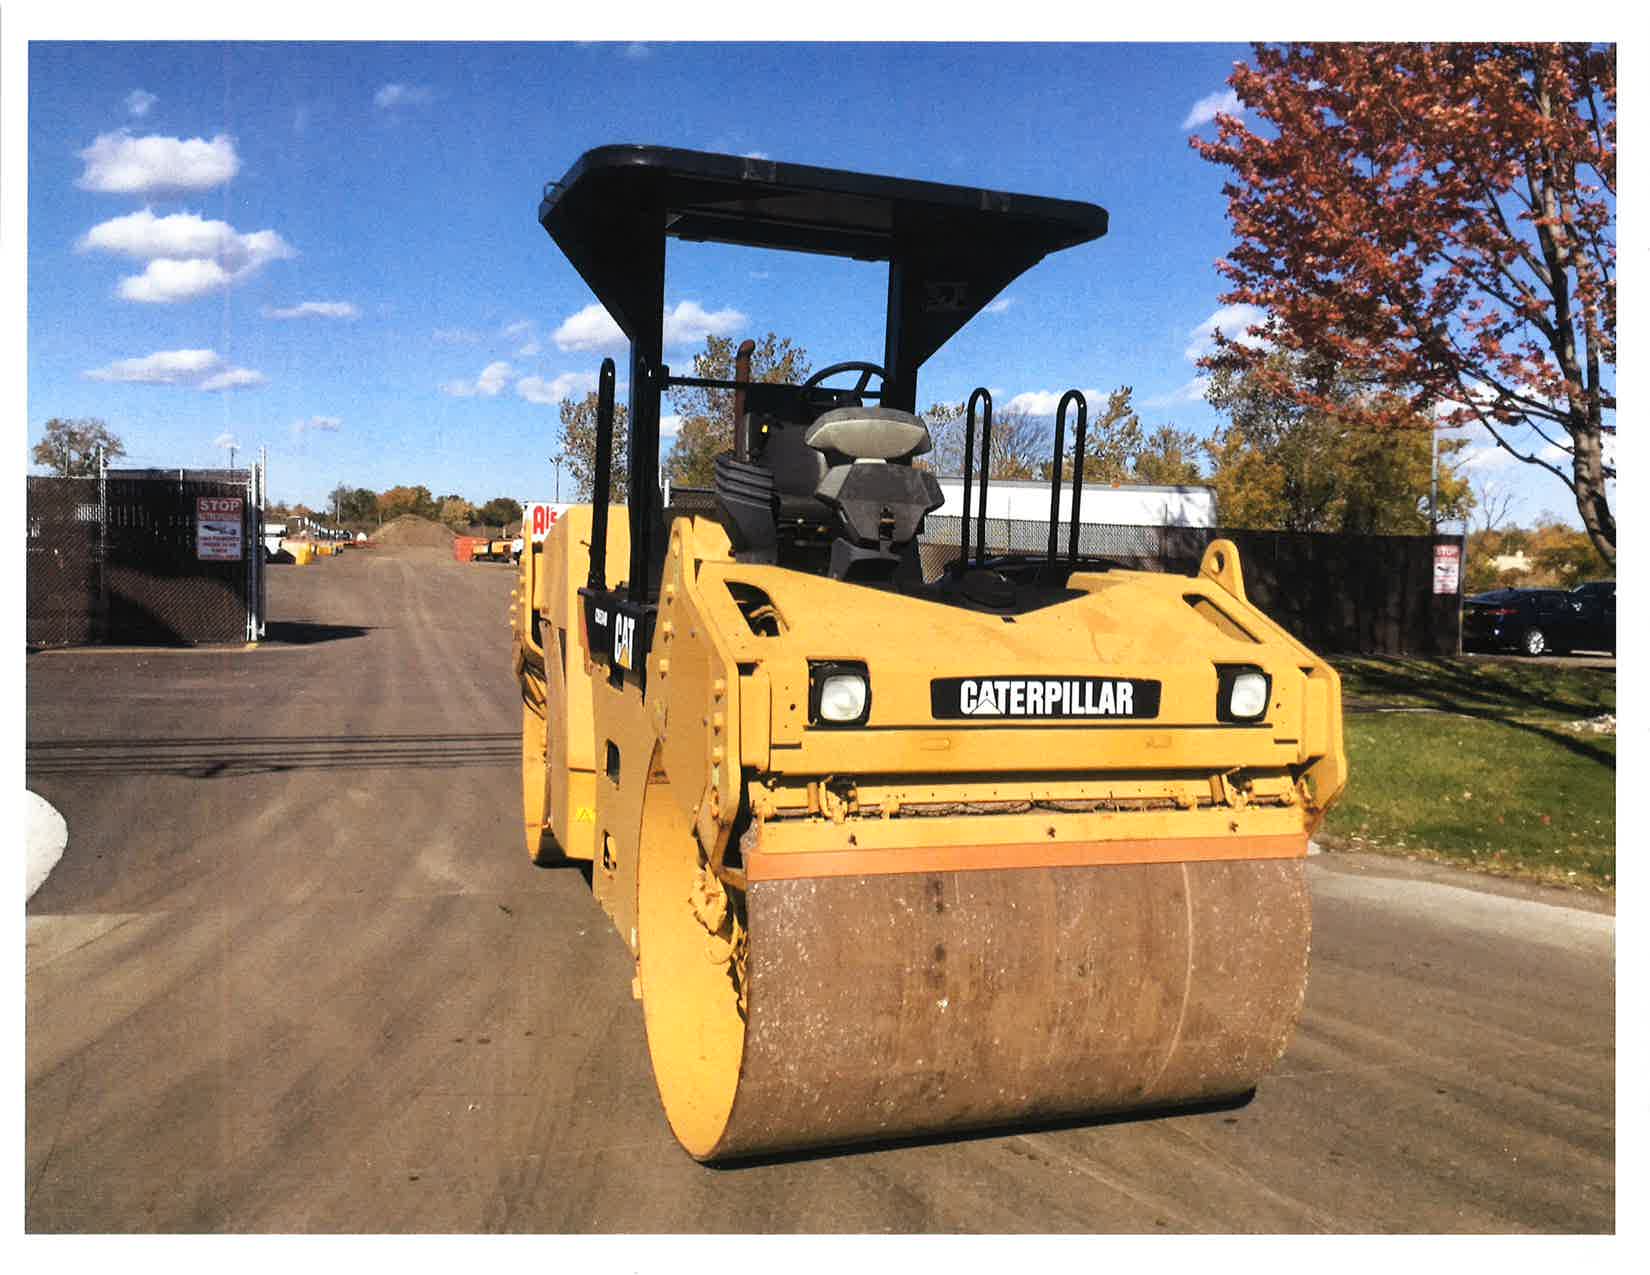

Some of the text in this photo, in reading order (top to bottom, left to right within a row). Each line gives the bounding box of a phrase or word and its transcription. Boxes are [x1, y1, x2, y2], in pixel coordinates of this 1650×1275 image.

[199, 500, 239, 511] STOP
[615, 613, 635, 671] CAT
[960, 680, 1133, 715] CATERPILLAR
